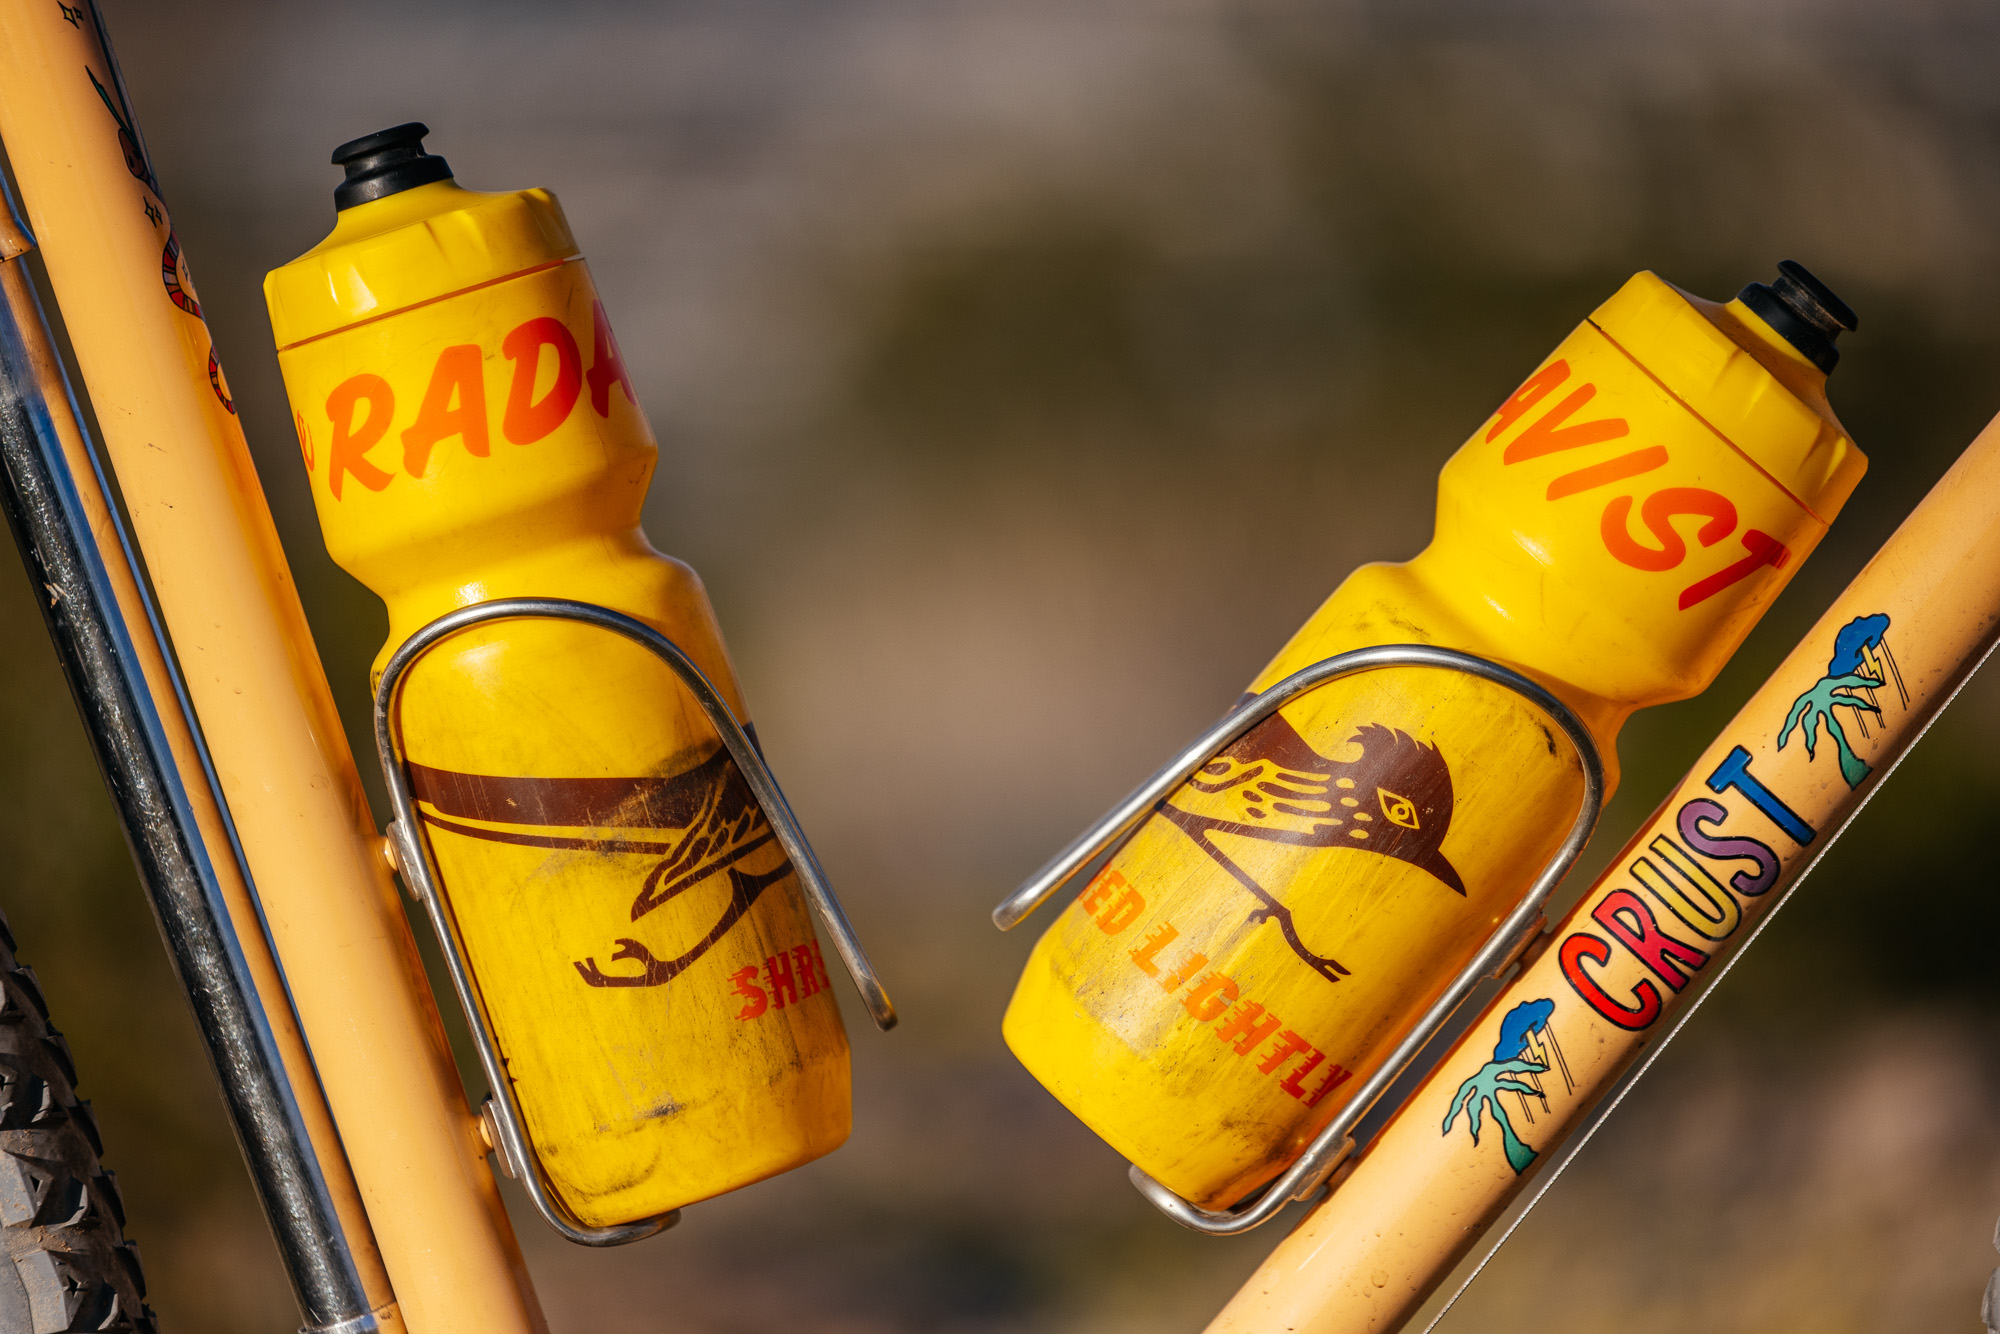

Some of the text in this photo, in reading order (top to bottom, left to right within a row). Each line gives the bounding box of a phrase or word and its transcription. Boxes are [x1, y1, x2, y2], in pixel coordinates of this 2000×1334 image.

[325, 298, 637, 502] RADA
[1558, 744, 1817, 1032] CRUST
[1127, 920, 1353, 1110] LIGHTLY
